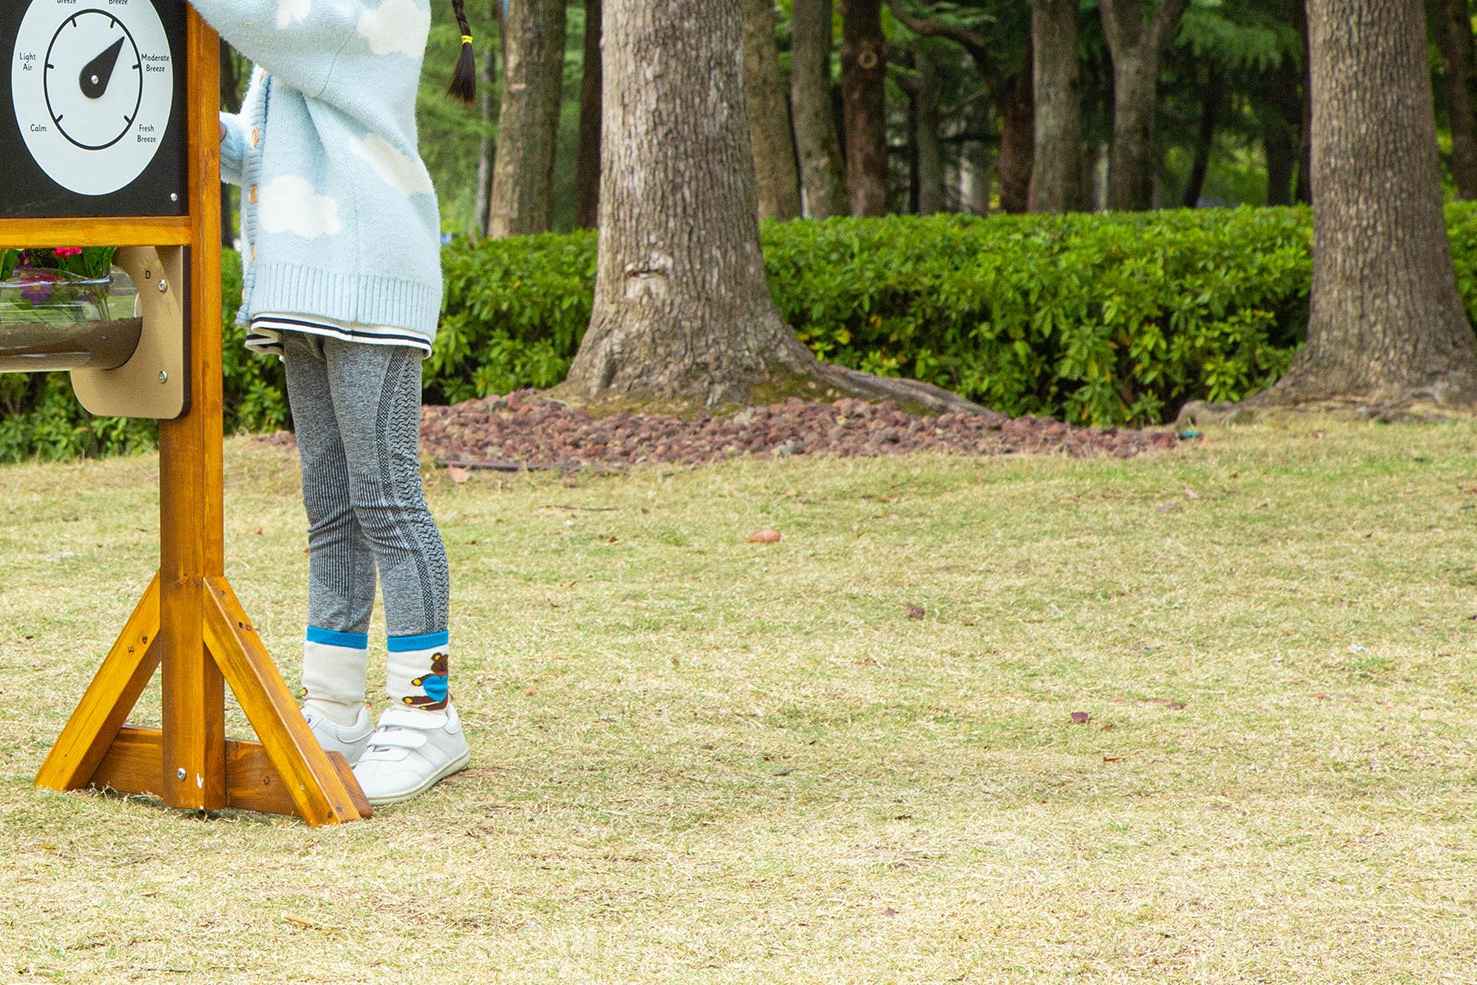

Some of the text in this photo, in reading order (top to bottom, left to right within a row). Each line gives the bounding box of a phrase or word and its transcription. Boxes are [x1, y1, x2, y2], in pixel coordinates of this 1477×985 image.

[20, 53, 36, 62] Light
[142, 54, 169, 62] Moderate
[23, 64, 33, 72] Air
[30, 124, 47, 132] Calm
[139, 124, 154, 132] Fresh
[137, 135, 156, 143] Breeze
